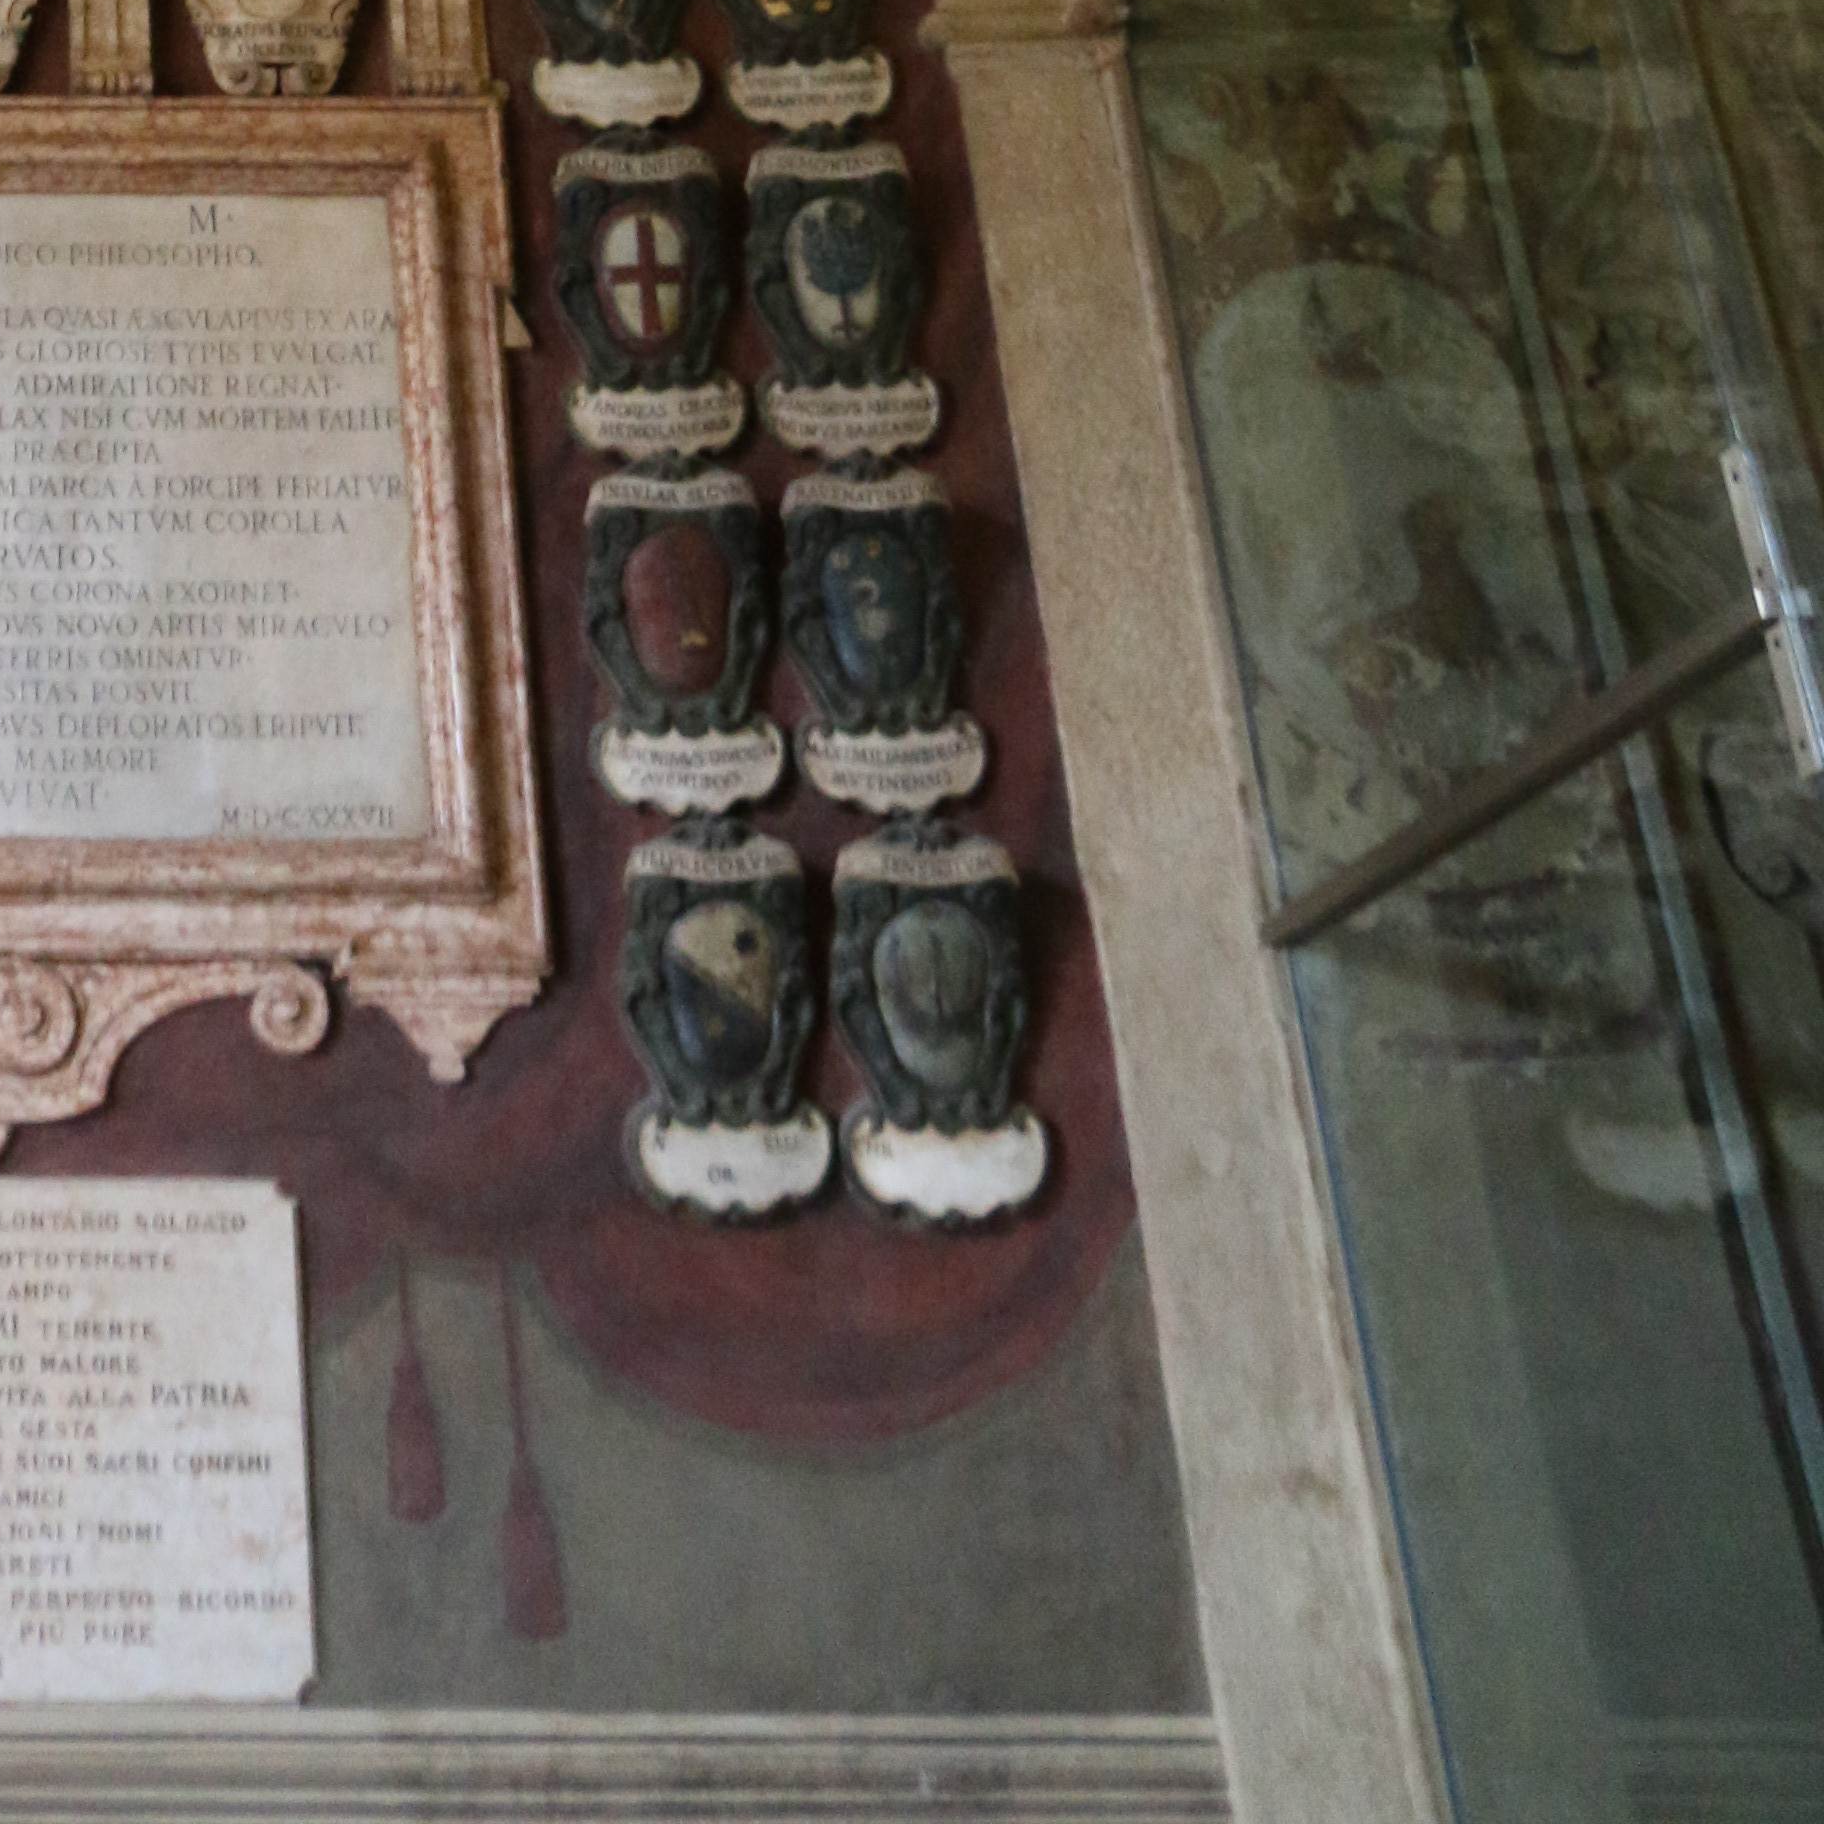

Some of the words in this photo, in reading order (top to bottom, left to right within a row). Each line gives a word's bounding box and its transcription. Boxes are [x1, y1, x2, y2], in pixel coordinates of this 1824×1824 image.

[71, 507, 192, 534] TANTVM
[55, 612, 139, 638] NOVO
[67, 1386, 135, 1408] ALLA
[151, 1382, 252, 1408] PATRIA
